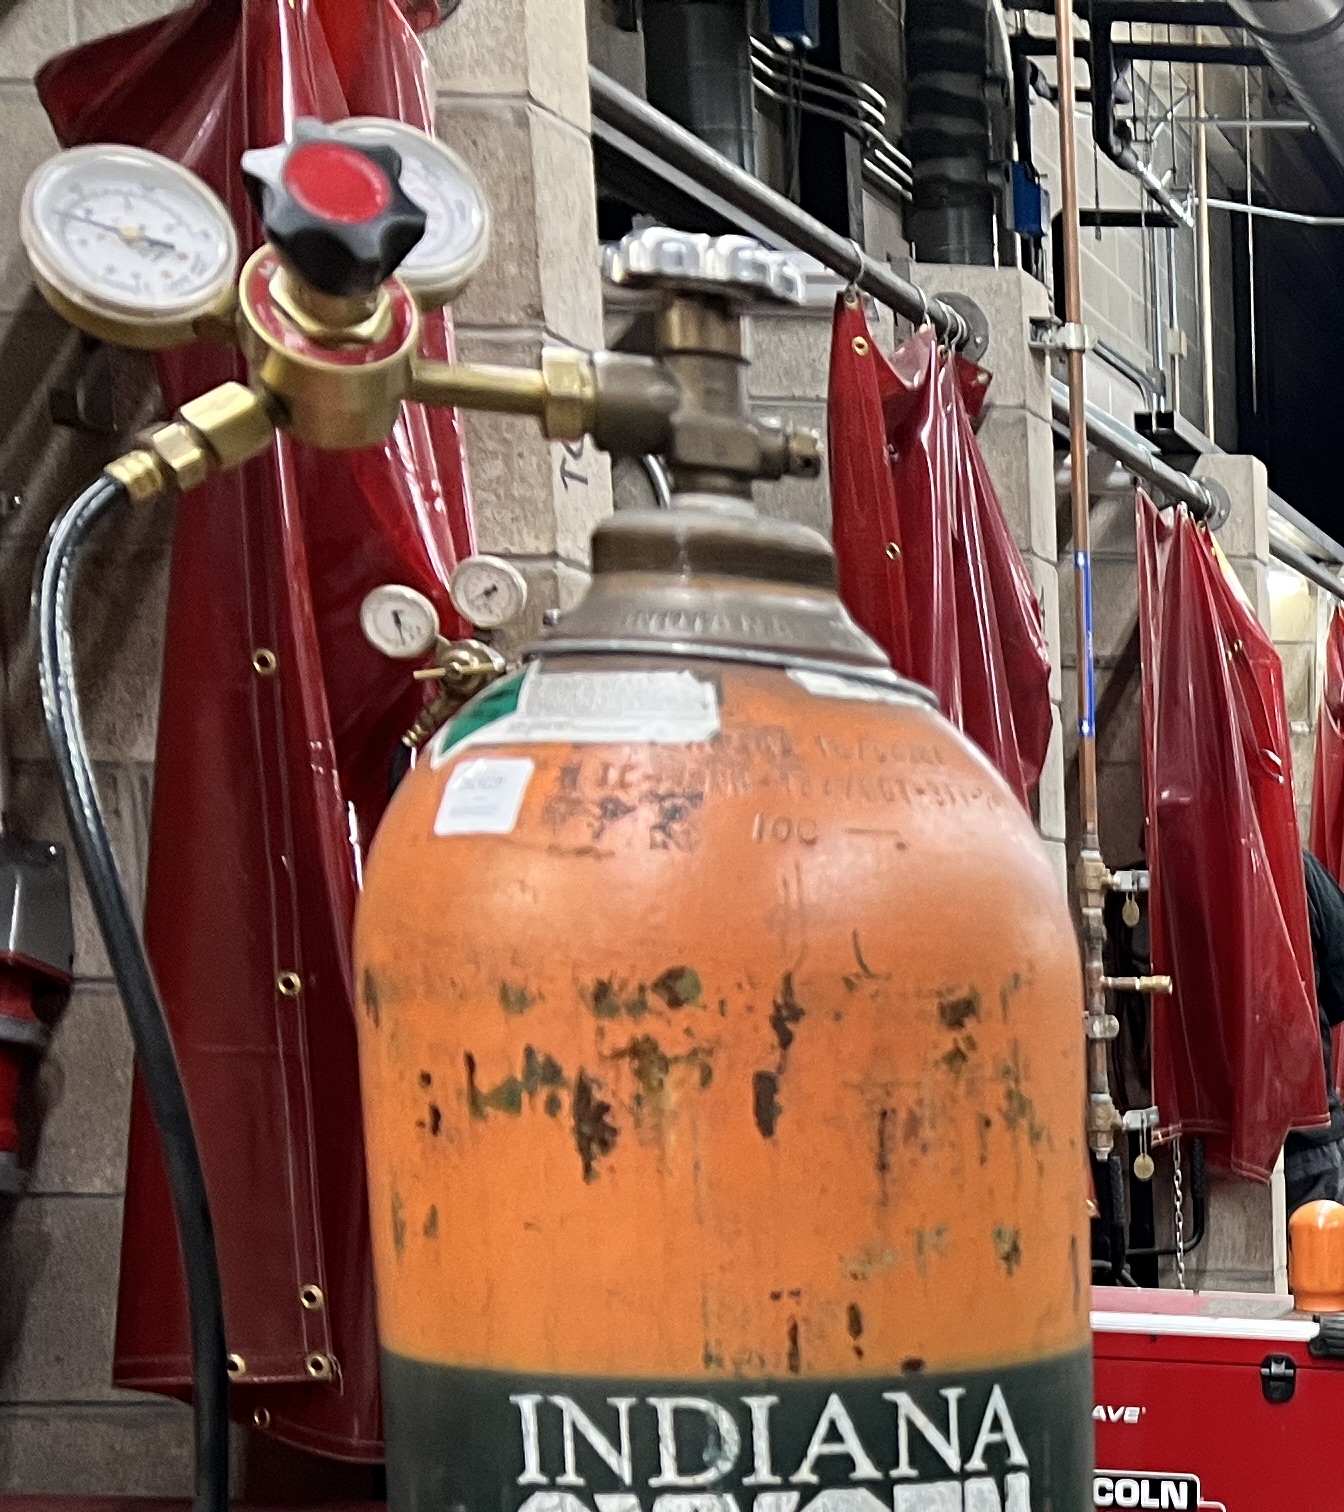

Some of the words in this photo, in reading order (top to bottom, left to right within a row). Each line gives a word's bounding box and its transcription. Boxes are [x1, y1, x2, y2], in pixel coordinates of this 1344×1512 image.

[1091, 1405, 1141, 1424] AVE
[509, 1383, 1031, 1488] INDIANA
[1092, 1477, 1189, 1511] COLN
